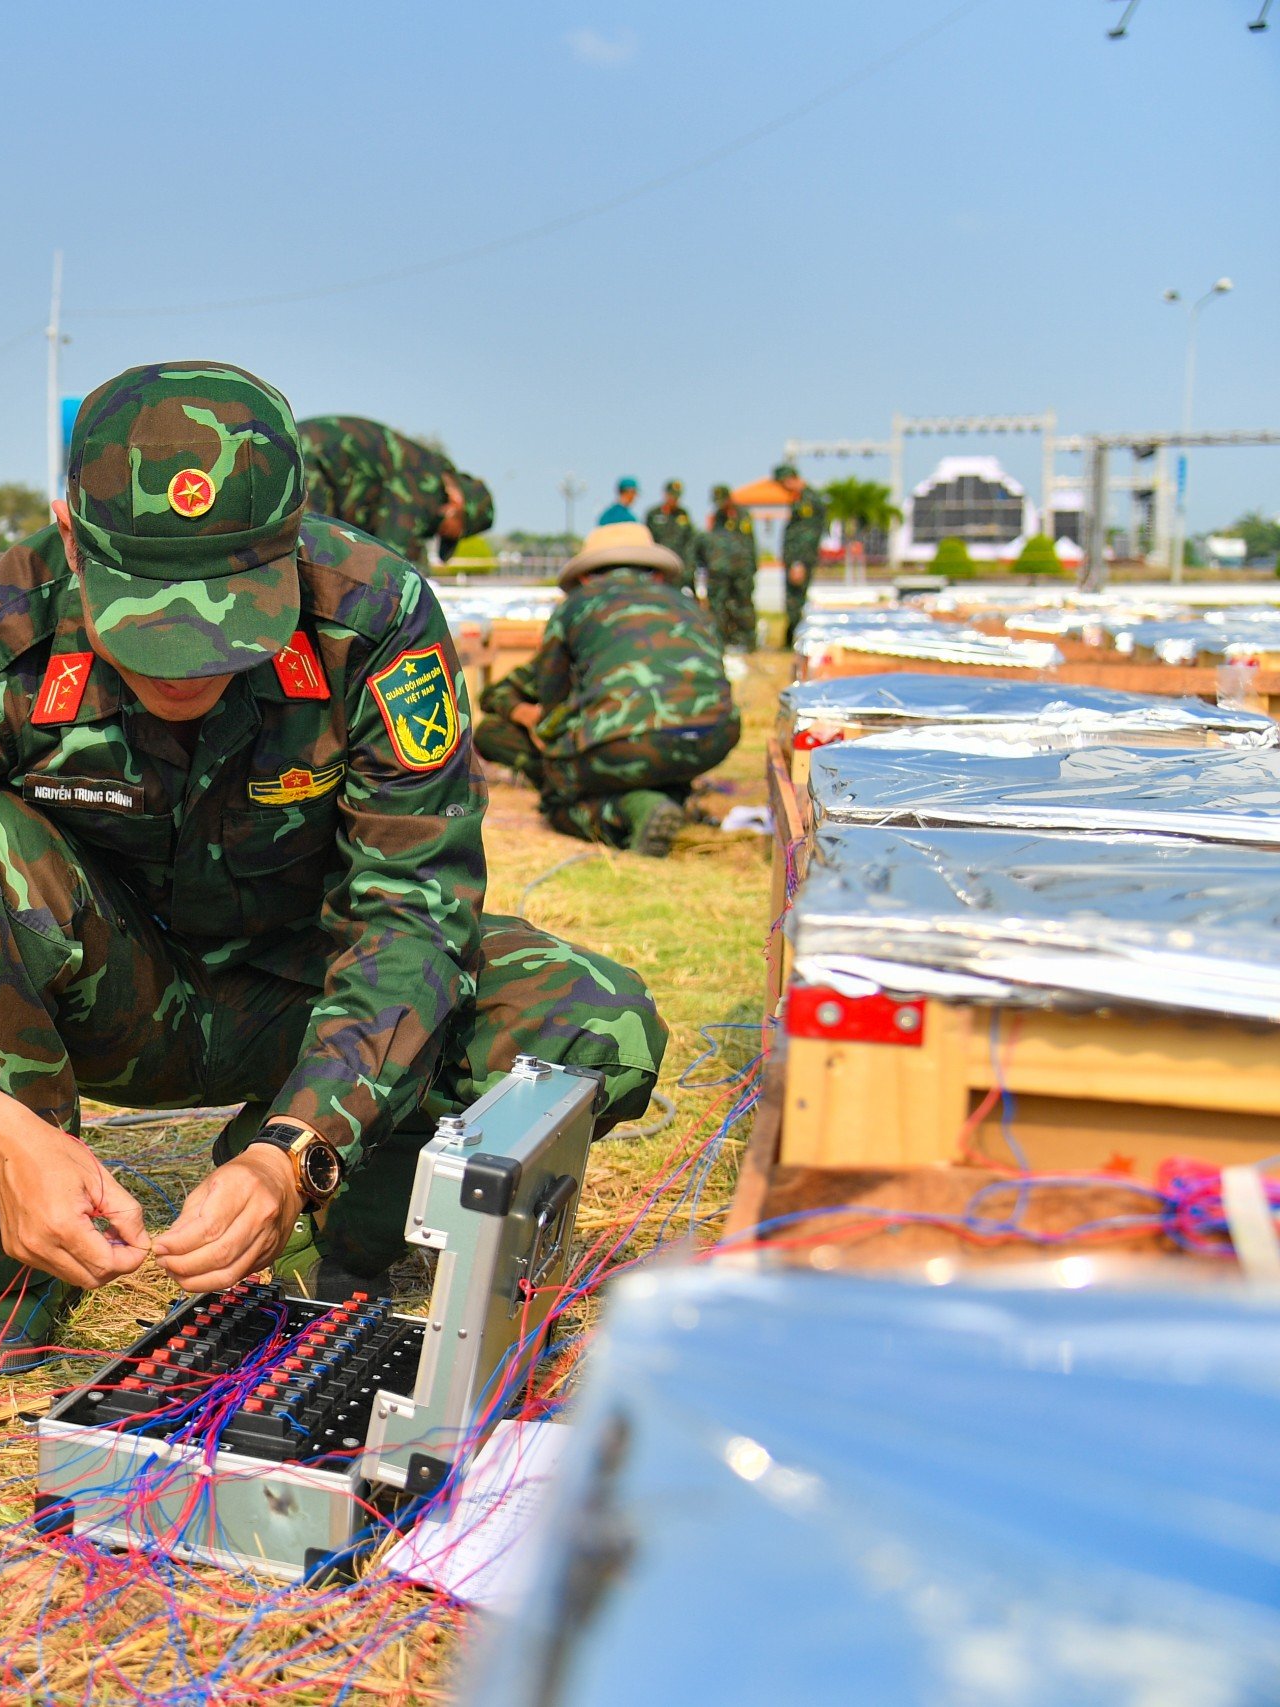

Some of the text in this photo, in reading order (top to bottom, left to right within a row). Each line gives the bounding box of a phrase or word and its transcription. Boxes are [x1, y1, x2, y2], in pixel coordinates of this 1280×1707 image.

[385, 686, 405, 700] QUÂN
[416, 673, 431, 687] NHÂN
[404, 684, 435, 704] VIỆT NAM
[74, 787, 103, 802] TRUNG
[105, 790, 133, 808] CHÍNH
